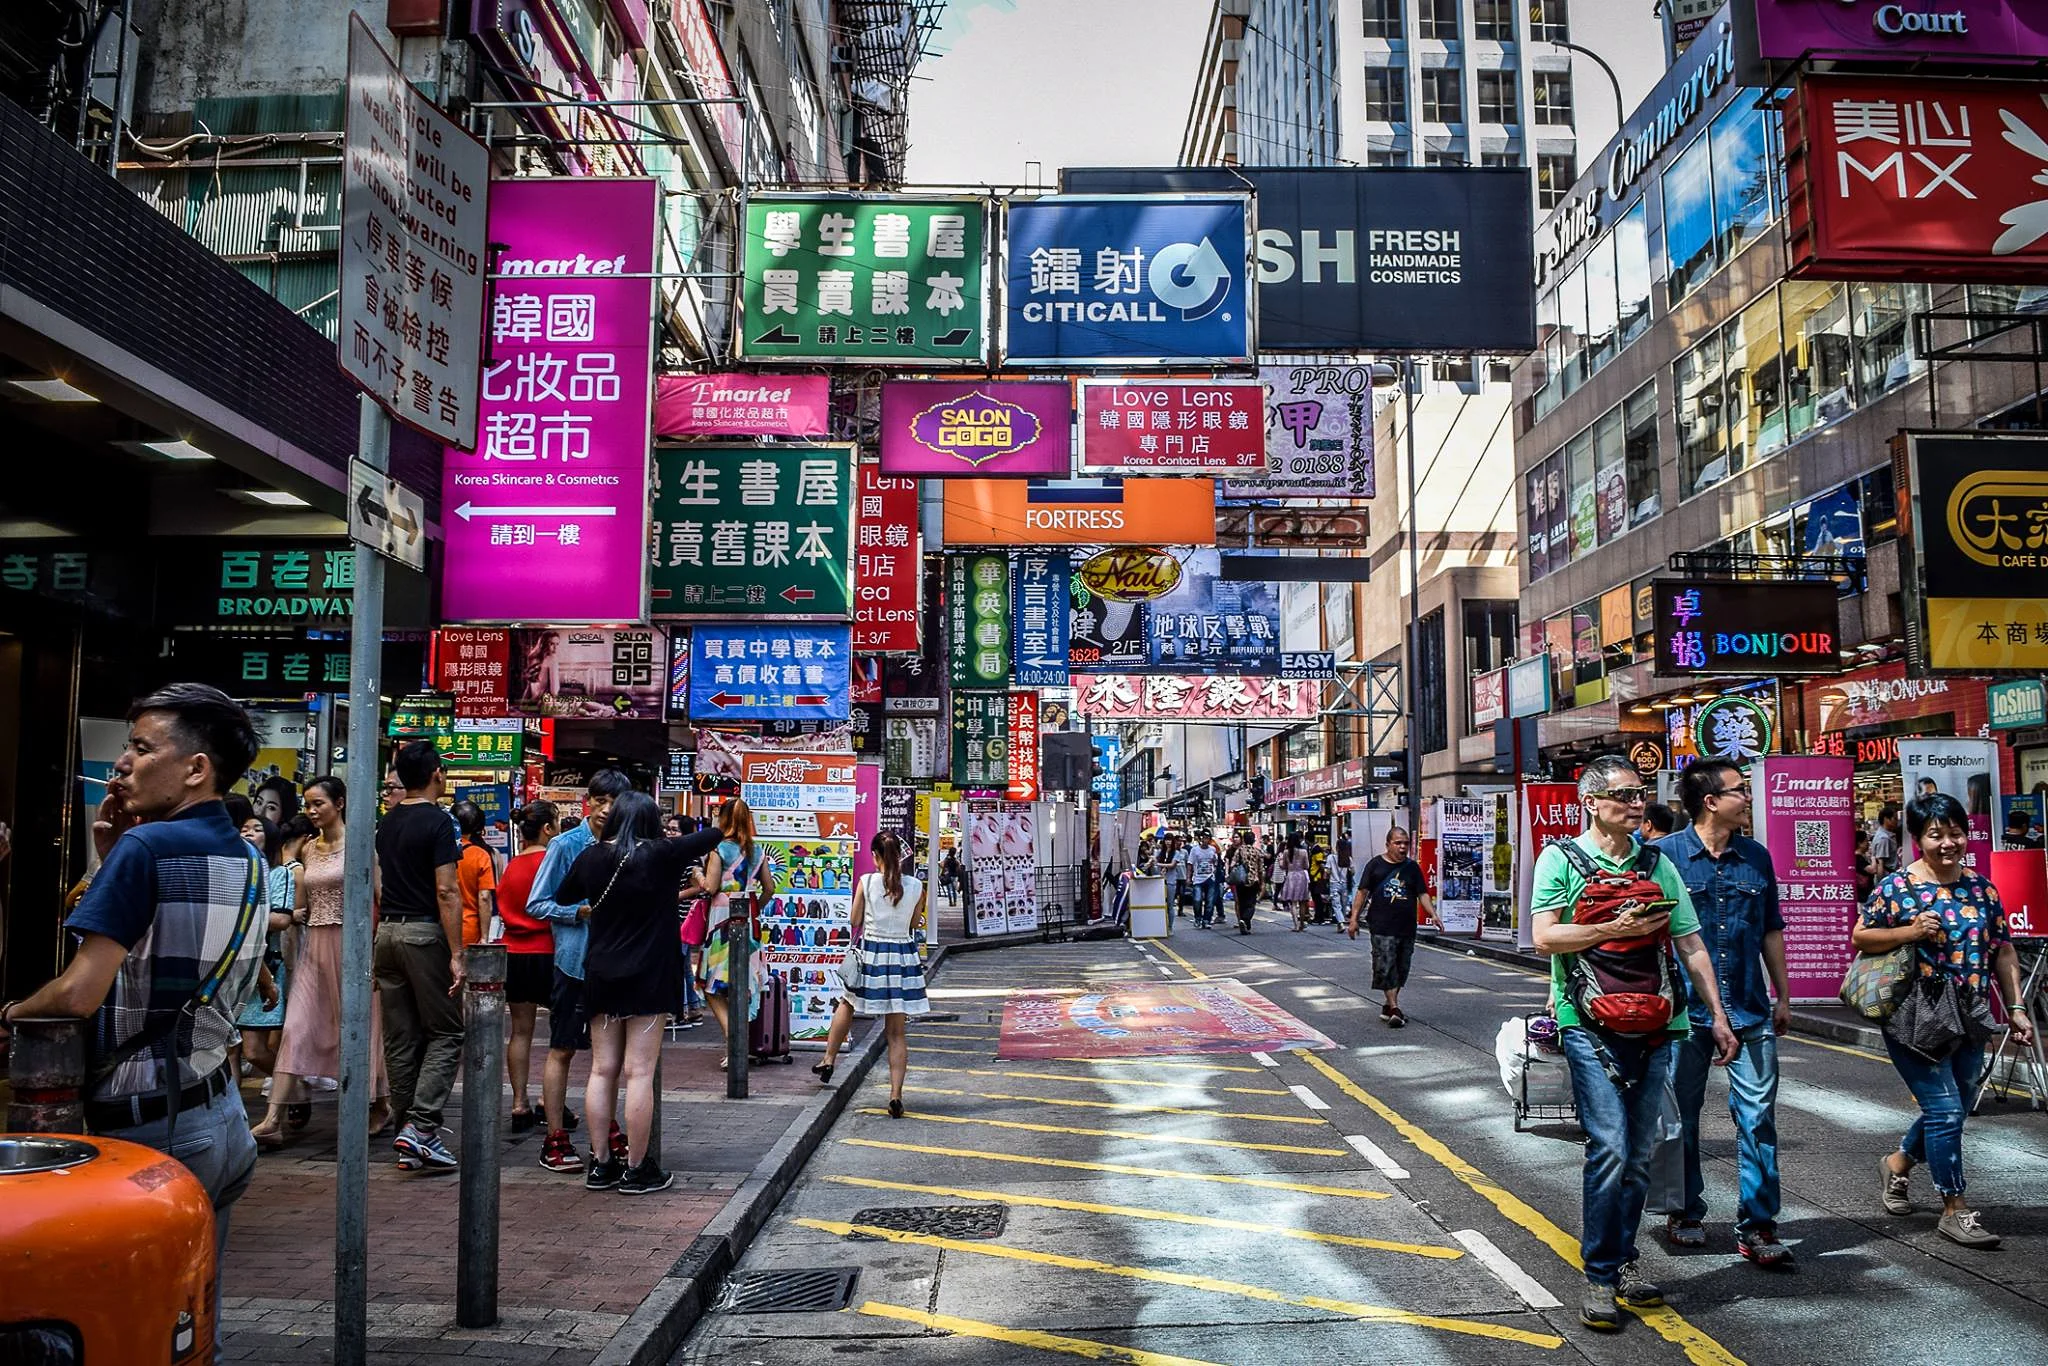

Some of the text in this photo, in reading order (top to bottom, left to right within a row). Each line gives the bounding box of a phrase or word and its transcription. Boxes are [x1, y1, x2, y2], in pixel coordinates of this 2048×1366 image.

[1875, 5, 1969, 34] Court
[386, 73, 443, 149] Vehicle
[1832, 99, 1972, 147] 美心
[361, 87, 473, 203] waiting will be
[370, 134, 457, 228] prosecuted
[1837, 151, 1979, 200] MX
[351, 150, 478, 276] without warning
[763, 211, 967, 259] 學生書屋
[1369, 230, 1460, 252] FRESH
[366, 211, 453, 313] 停車等候
[1028, 245, 1146, 297] 鐳射
[1369, 254, 1461, 268] HANDMADE
[1369, 270, 1462, 284] COSMETICS
[761, 269, 966, 318] 買賣課本
[365, 274, 451, 368] 會被檢控
[493, 293, 596, 344] 韓國
[1022, 300, 1167, 324] CITICALL
[817, 325, 916, 347] 請上二樓
[352, 319, 460, 428] 而不予警告
[1289, 366, 1369, 395] PRO
[691, 382, 791, 406] Emarket
[1112, 387, 1234, 407] Love Lens
[691, 407, 788, 419] 韓國化妝品超市
[713, 420, 744, 428] Skincare
[751, 420, 788, 428] Cosmetics
[940, 408, 1012, 426] SALON
[1099, 410, 1249, 430] 韓國隱形眼鏡
[1276, 400, 1324, 449] 甲
[483, 410, 593, 462] 超市
[938, 427, 1012, 446] GOGO
[1138, 435, 1211, 454] 專門店
[1123, 454, 1258, 466] Korea Contact Lens 3/F
[1290, 454, 1345, 474] 0188
[454, 474, 620, 485] Korea Skincare & Cosmetics
[865, 472, 916, 491] Lens
[1025, 510, 1125, 529] FORTRESS
[490, 524, 581, 546] 請到一樓
[1088, 553, 1165, 589] Nail
[2002, 553, 2037, 568] CAFÉ
[684, 584, 767, 605] 請上二樓
[877, 607, 916, 622] Lens
[953, 556, 966, 657] 買賣中學新舊課本
[1022, 557, 1049, 655] 序言書室
[978, 562, 1002, 674] 華英書局
[1153, 613, 1275, 640] 地球反擊戰
[444, 631, 504, 642] Love Lens
[613, 632, 653, 642] SALON
[869, 631, 892, 646] 3/F
[1112, 640, 1140, 655] 2/F
[1715, 632, 1833, 655] BONJOUR
[459, 644, 488, 659] 韓國
[703, 638, 836, 660] 買賣中學課本
[444, 662, 503, 677] 隱形眼鏡
[1281, 653, 1333, 669] EASY
[714, 663, 825, 685] 高價收舊書
[1020, 670, 1066, 684] 14:00-24:00
[1281, 670, 1333, 679] 62421618
[461, 696, 489, 704] Contact
[482, 706, 497, 715] 3/F
[1992, 686, 2042, 718] JoShin
[437, 734, 513, 752] 學生書屋
[966, 696, 985, 781] 中學舊書
[1008, 696, 1018, 781] MONEY EXCHANGE
[1018, 696, 1035, 781] 人民幣找換
[1711, 706, 1759, 761] 藥
[1908, 755, 1985, 769] EF Englishtown
[1092, 781, 1118, 790] OPEN
[1770, 772, 1850, 794] Emarket
[1771, 796, 1851, 808] 韓國化妝品超市
[1531, 803, 1581, 827] 人民幣
[1789, 869, 1838, 877] ID: Emarket-hk
